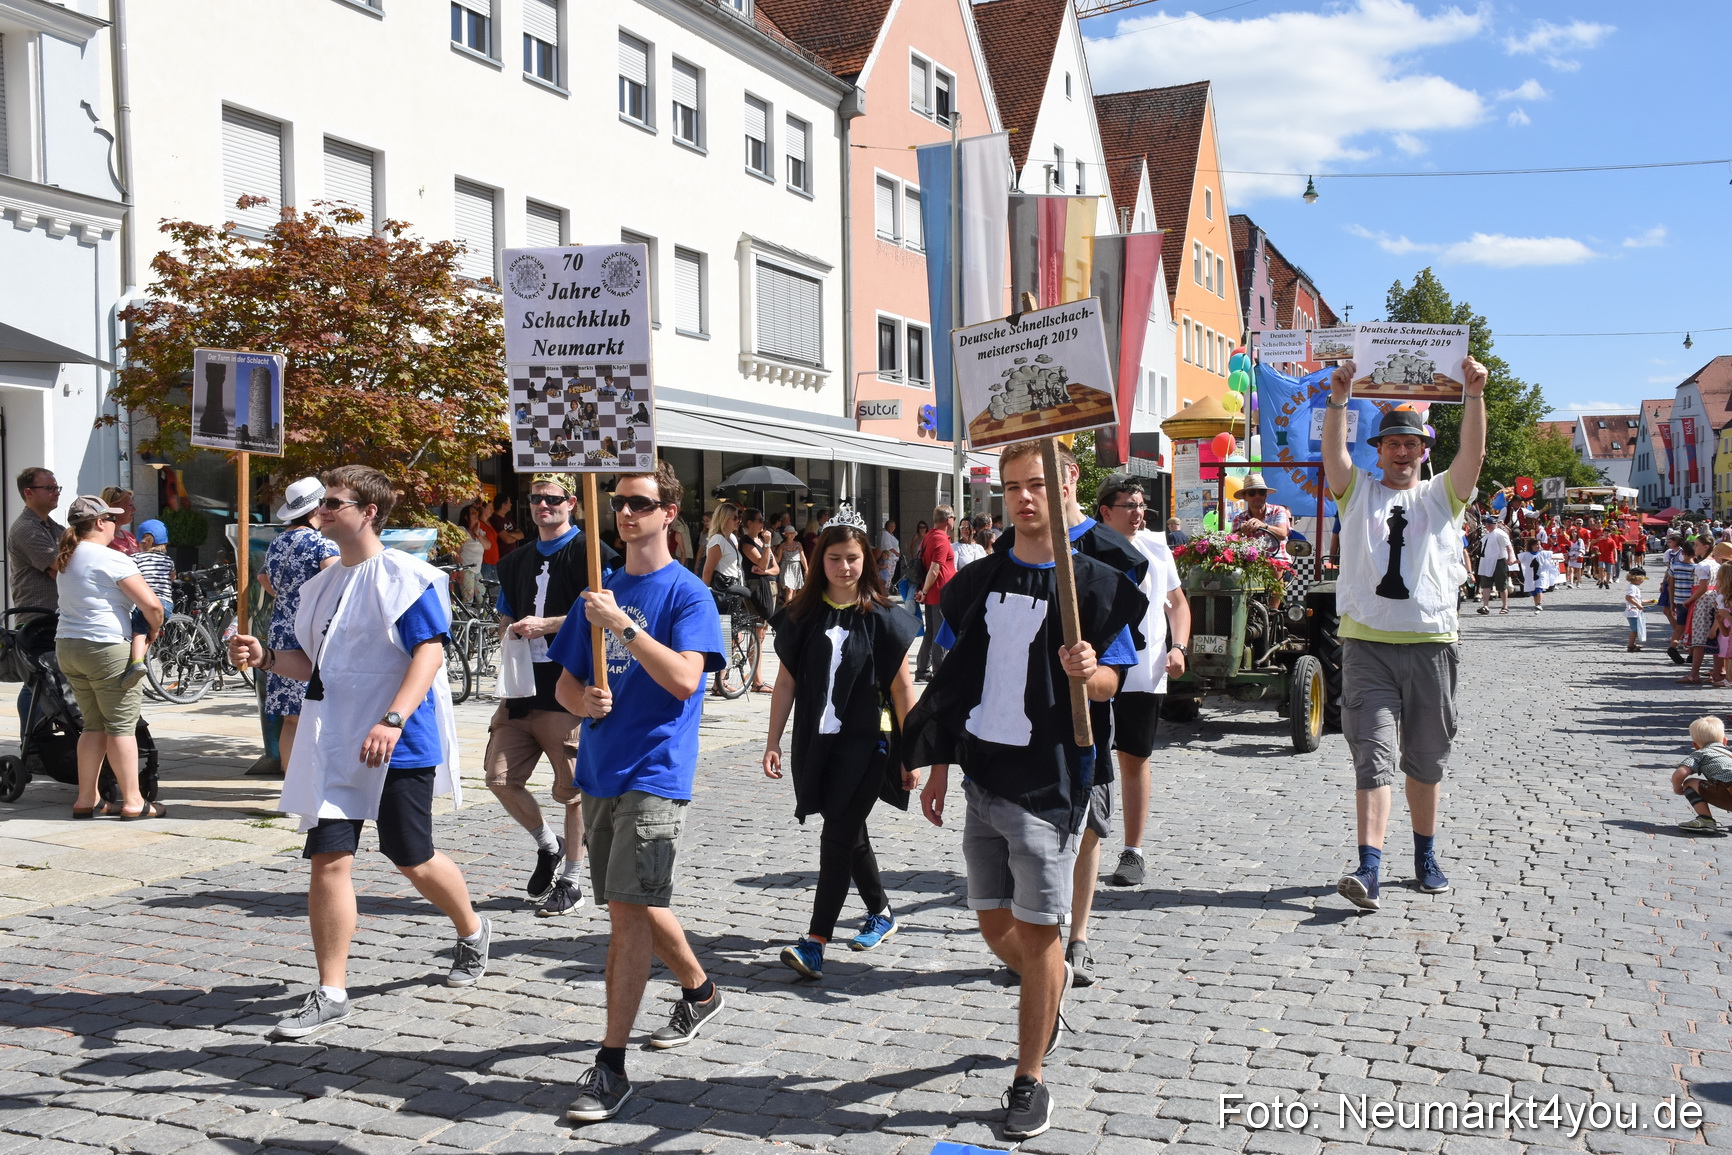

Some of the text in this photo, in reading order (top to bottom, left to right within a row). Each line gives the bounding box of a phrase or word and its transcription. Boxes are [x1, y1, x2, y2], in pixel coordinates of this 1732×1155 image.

[510, 254, 544, 272] SCHACHKLUB
[563, 253, 583, 271] 70
[601, 251, 639, 269] SCHACHKLUB
[510, 282, 540, 300] NEUMARKT
[547, 282, 601, 300] Jahre
[601, 279, 634, 297] NEUMARKT
[522, 309, 630, 329] Schachklub
[959, 307, 1094, 347] Deutsche Schnellschach-
[1360, 326, 1465, 337] Deutsche Schnellschach-
[532, 338, 624, 357] Neumarkt
[977, 328, 1078, 360] meisterschaft 2019
[1371, 337, 1452, 347] meisterschaft 2019
[207, 353, 217, 361] Der
[246, 356, 269, 365] Schlacht
[858, 403, 898, 416] sutor.
[1195, 644, 1223, 653] DR 46
[1204, 636, 1216, 644] NM
